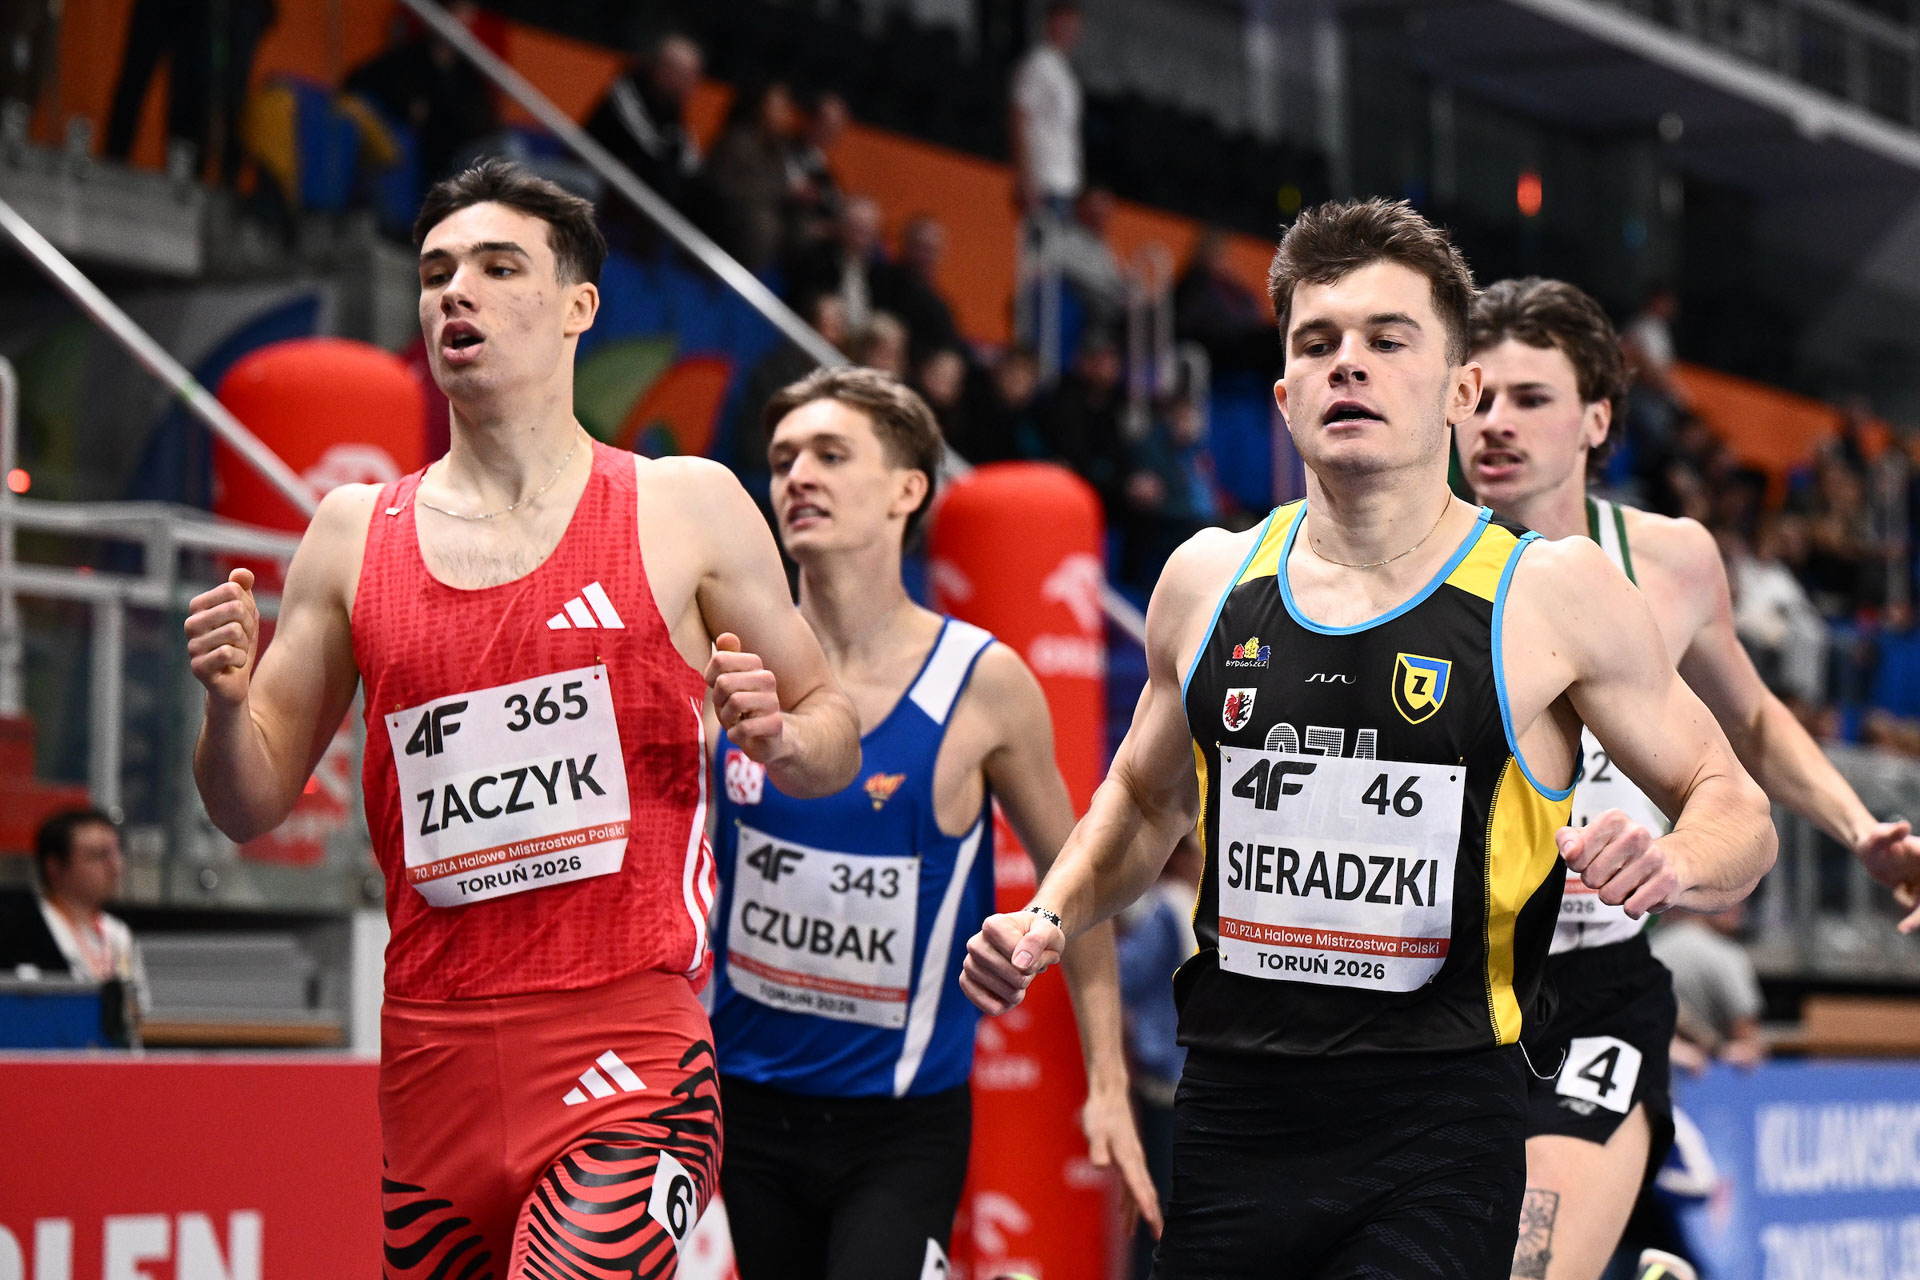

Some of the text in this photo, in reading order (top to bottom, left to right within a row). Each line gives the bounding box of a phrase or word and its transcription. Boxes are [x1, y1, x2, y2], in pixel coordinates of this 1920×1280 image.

[504, 681, 588, 732] 365
[1411, 675, 1428, 696] Z
[405, 700, 468, 758] 4F
[417, 753, 606, 836] ZACZYK
[1232, 758, 1317, 811] 4F
[1361, 773, 1423, 817] 46
[414, 823, 625, 880] 70. PZLA Halowe Mistrzostwa Polski
[457, 855, 582, 895] TORUŃ 2026
[746, 843, 804, 883] 4F
[1227, 841, 1438, 907] SIERADZKI
[829, 863, 900, 899] 343
[741, 901, 898, 964] CZUBAK
[1559, 900, 1595, 914] 026
[1225, 921, 1440, 954] 70. PZLA Halowe Mistrzostwa Polski
[1257, 952, 1385, 980] TORUŃ 2026
[1577, 1046, 1621, 1097] 4
[667, 1174, 693, 1240] 6
